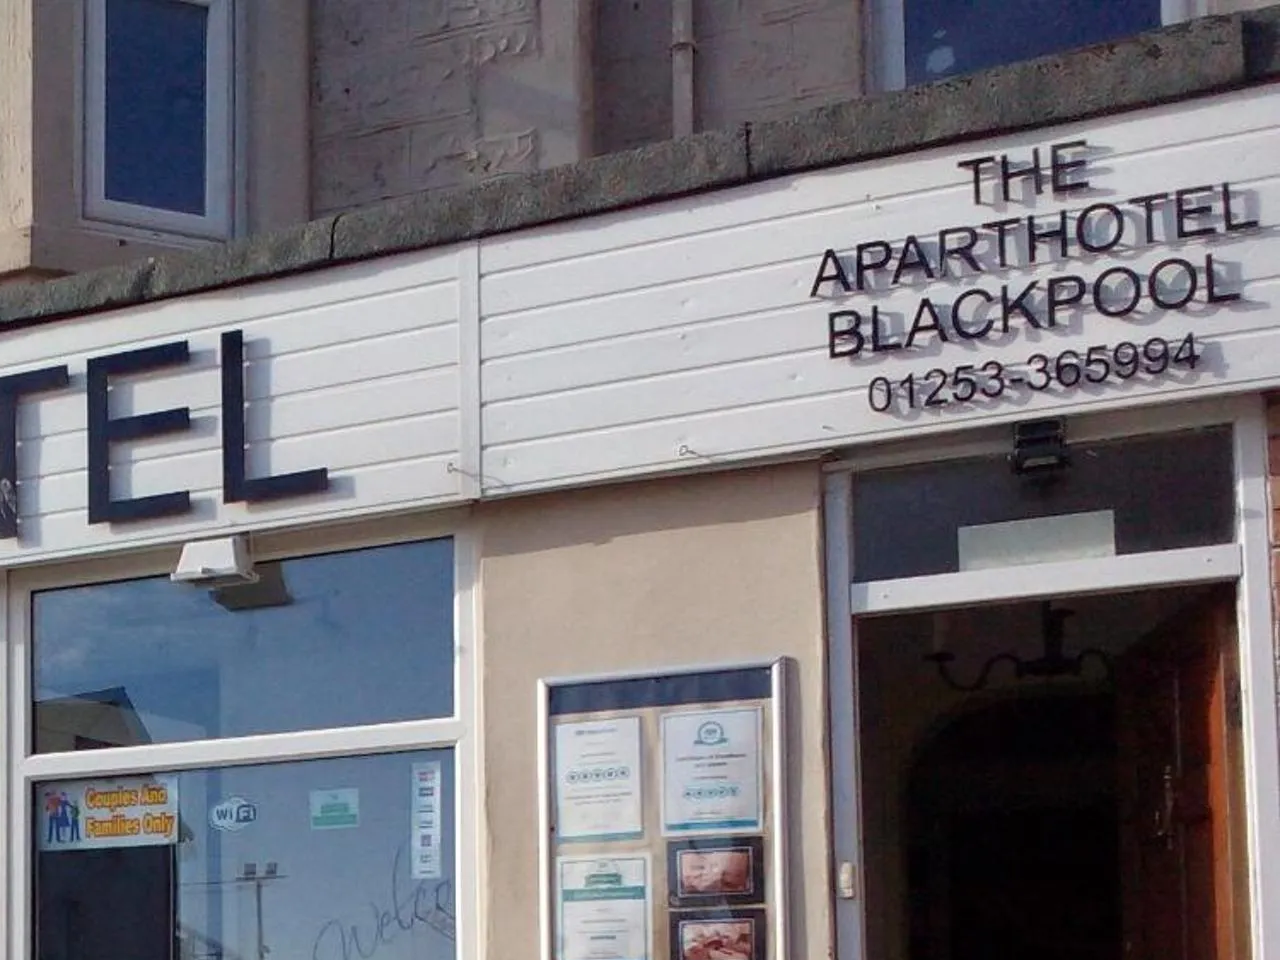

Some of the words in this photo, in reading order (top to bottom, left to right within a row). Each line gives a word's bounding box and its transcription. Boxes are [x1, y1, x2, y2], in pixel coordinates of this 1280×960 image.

[957, 139, 1089, 205] THE
[810, 182, 1260, 298] APARTHOTEL
[827, 253, 1242, 359] BLACKPOOL
[867, 332, 1201, 413] 01253-365994
[85, 815, 140, 838] Families
[142, 812, 175, 837] Only
[86, 787, 137, 811] Couples
